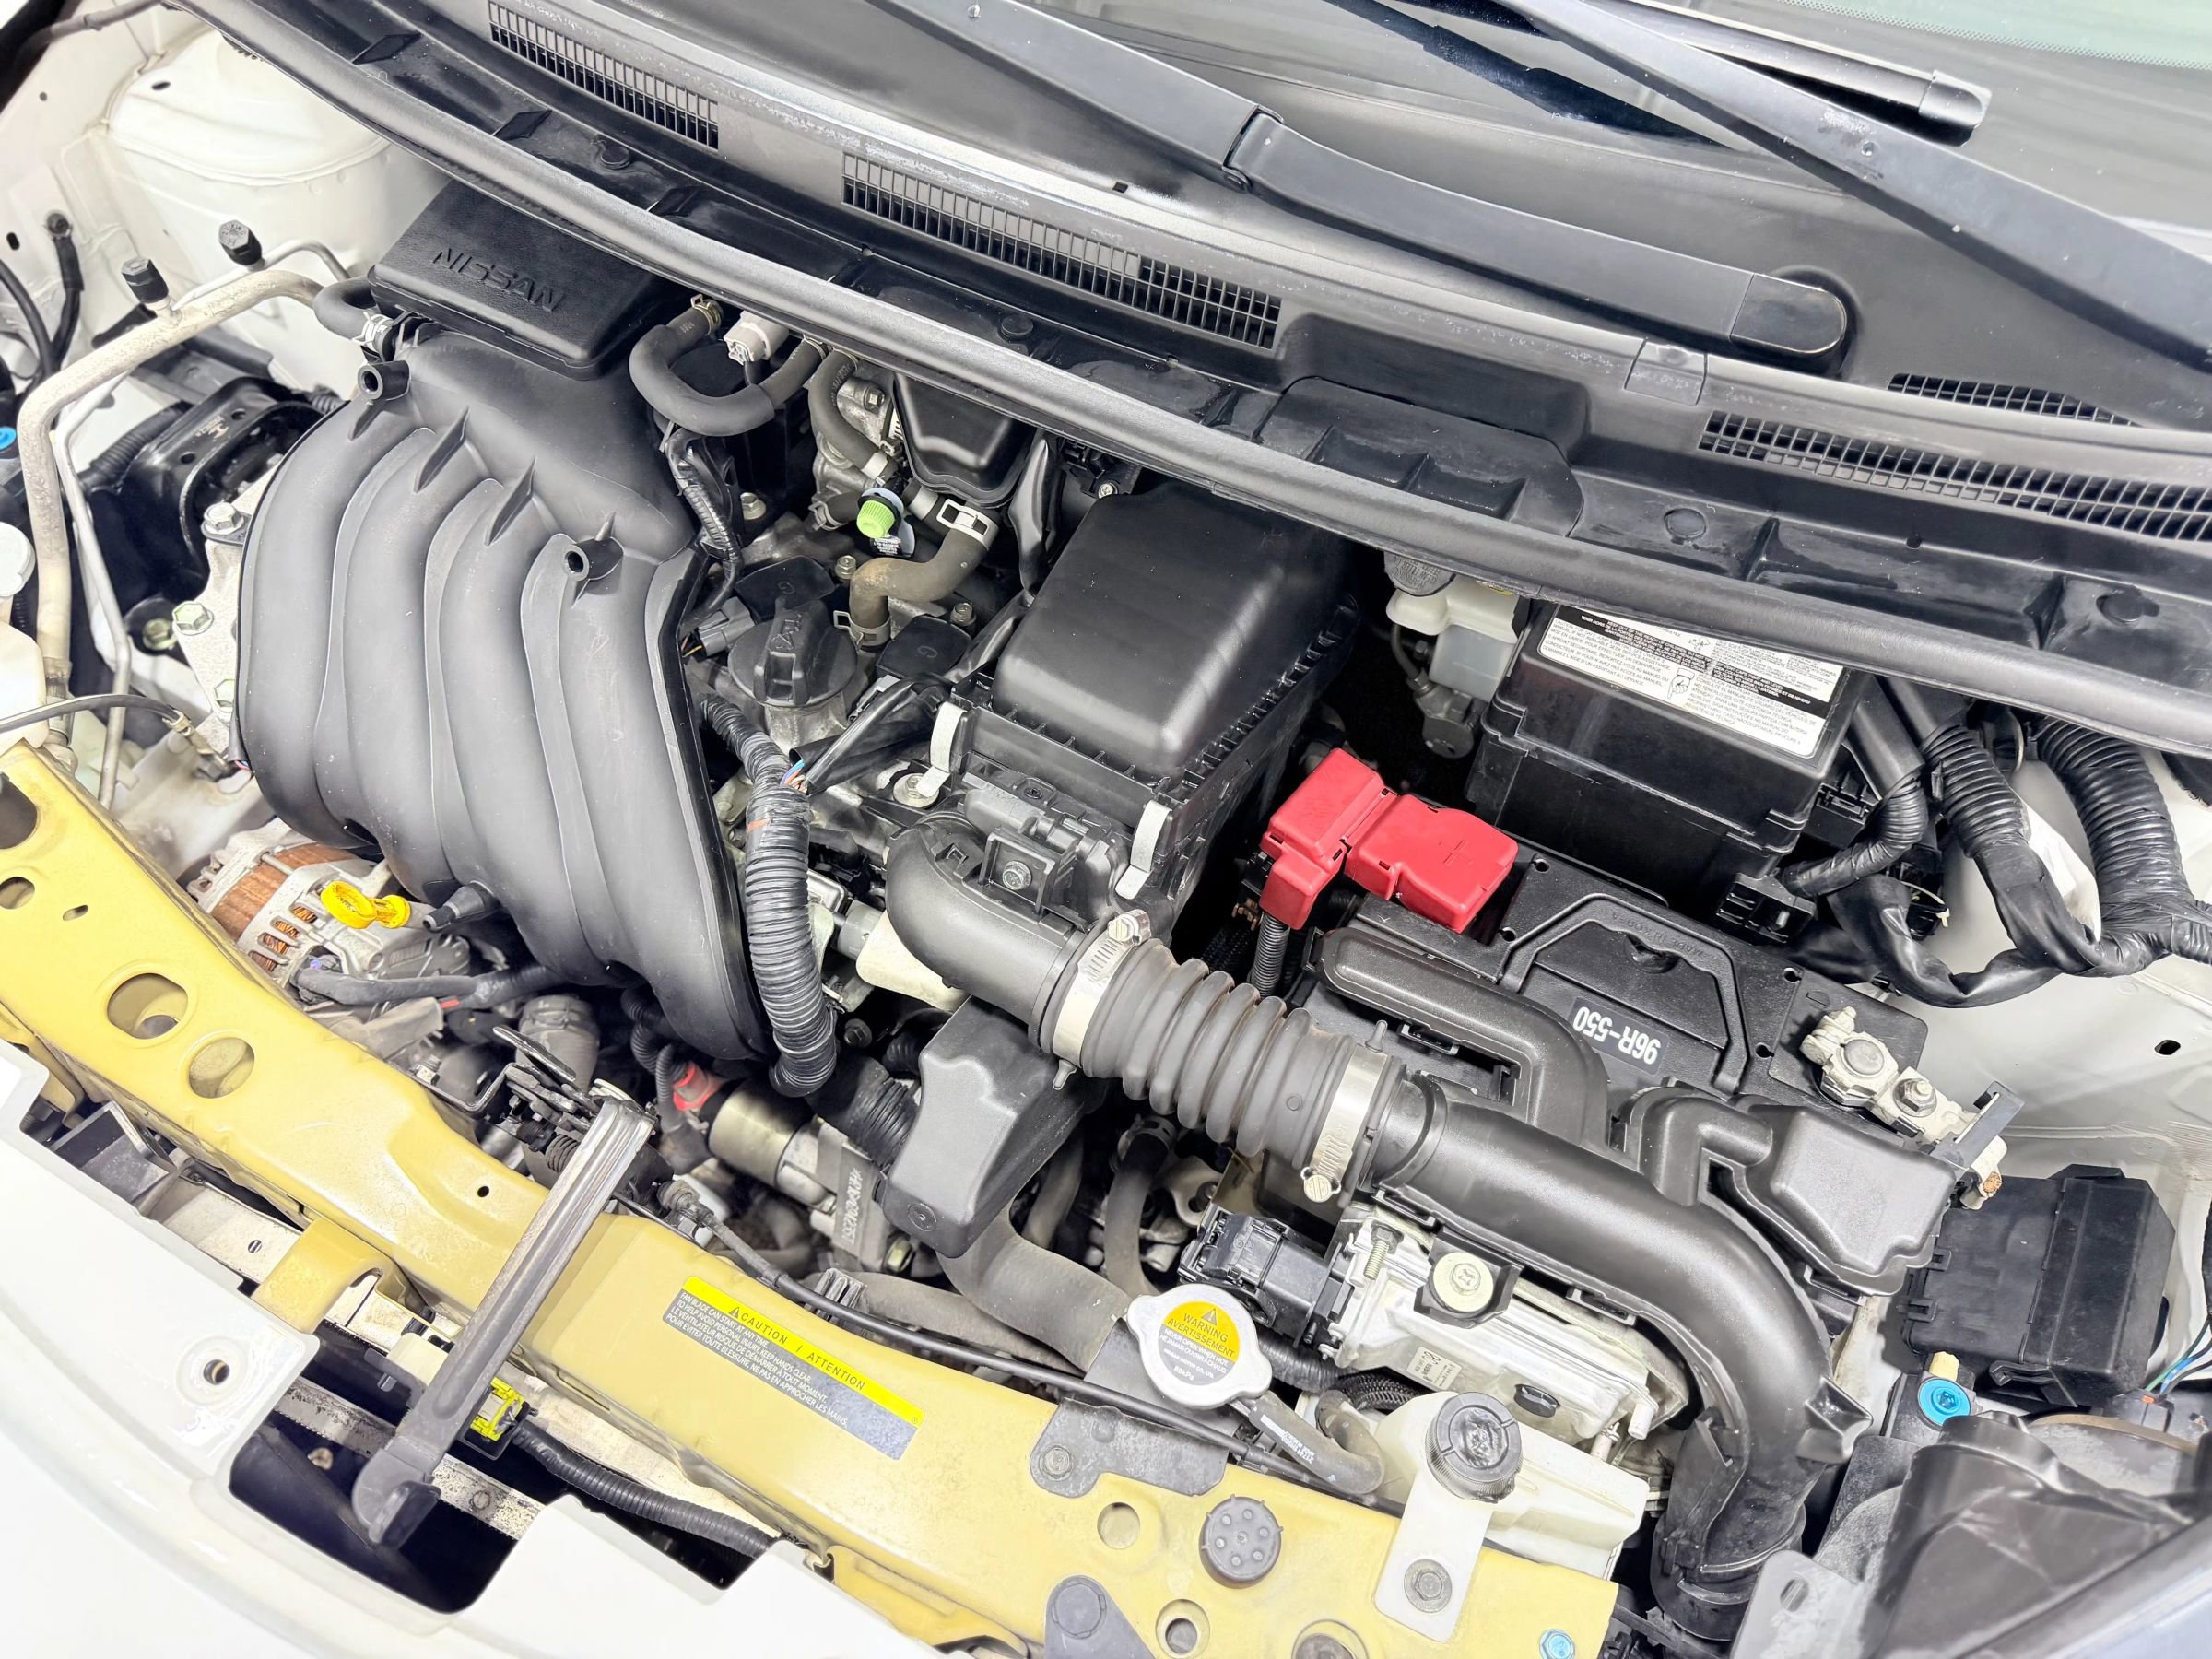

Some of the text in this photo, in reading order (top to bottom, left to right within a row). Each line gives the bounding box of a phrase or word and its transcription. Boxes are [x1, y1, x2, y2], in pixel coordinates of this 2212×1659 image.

[432, 246, 569, 313] NISSAN
[1573, 1006, 1662, 1065] 96R-550
[676, 1299, 686, 1309] TO
[683, 1302, 700, 1316] HELP
[697, 1311, 716, 1326] AVOID
[713, 1321, 742, 1342] PERSONAL
[759, 1347, 775, 1362] KEEP
[772, 1356, 794, 1373] HANDS
[679, 1290, 693, 1303] FAN
[690, 1297, 710, 1313] BLADE
[707, 1307, 722, 1320] CAN
[719, 1314, 737, 1330] START
[734, 1324, 745, 1334] AT
[742, 1328, 757, 1341] ANY
[1168, 1318, 1235, 1358] AVERTISSEMENT
[1183, 1313, 1228, 1343] WARNING
[665, 1312, 684, 1327] POUR
[681, 1321, 704, 1339] ÉVITER
[700, 1333, 723, 1350] TOUTE
[749, 1362, 761, 1373] NE
[758, 1368, 772, 1381] PAS
[770, 1374, 781, 1385] EN
[778, 1380, 817, 1406] APPROCHER
[814, 1401, 828, 1414] LES
[677, 1309, 717, 1337] VENTILATEUR
[713, 1331, 738, 1349] RISQUE
[735, 1344, 747, 1355] DE
[781, 1371, 799, 1386] TOUT
[796, 1381, 829, 1404] MOMENT.
[739, 1311, 787, 1345] CAUTION
[806, 1351, 865, 1391] ATTENTION
